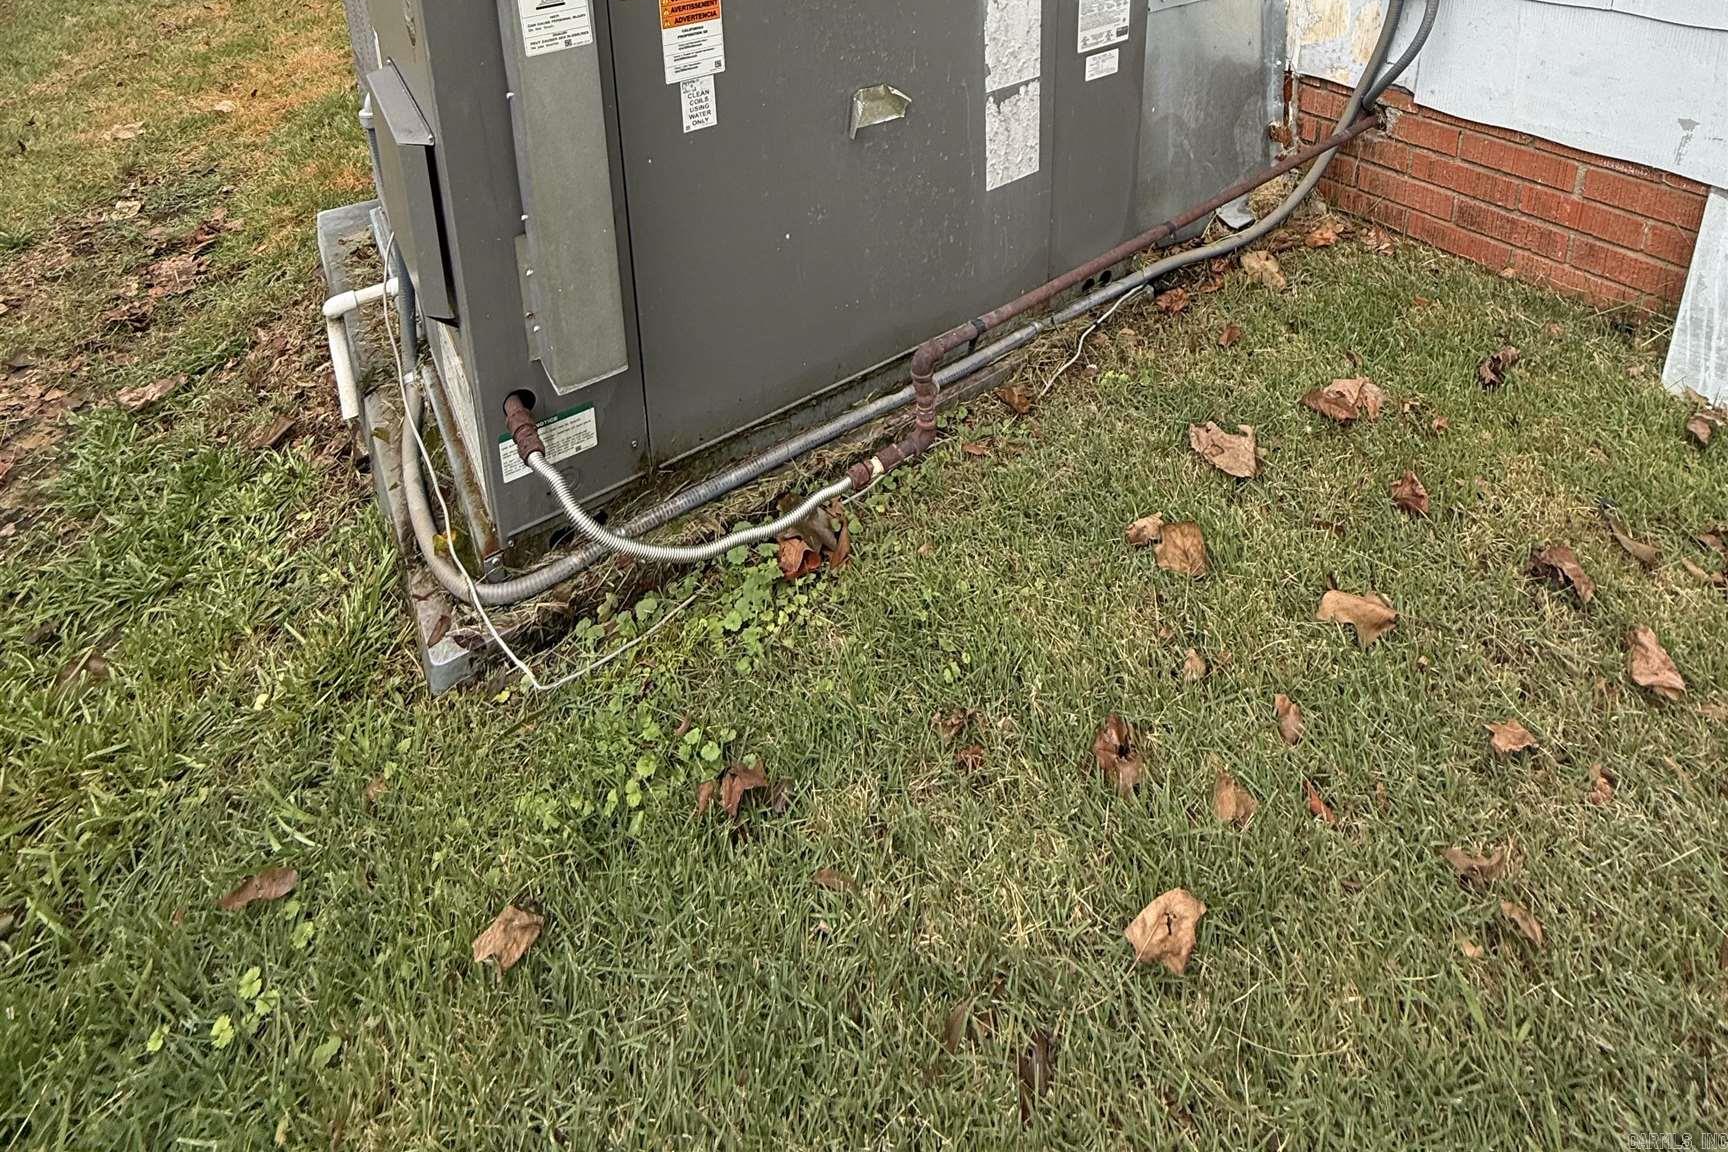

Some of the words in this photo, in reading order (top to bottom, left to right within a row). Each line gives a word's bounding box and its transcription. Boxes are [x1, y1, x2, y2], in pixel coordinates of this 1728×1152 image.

[671, 0, 718, 13] AVERTISSEMENT
[675, 10, 717, 24] ADVERTENCIA
[687, 89, 709, 99] CLEAN
[689, 96, 709, 106] COILS
[689, 103, 710, 113] USING
[688, 110, 711, 120] WATER
[692, 117, 709, 126] ONLY
